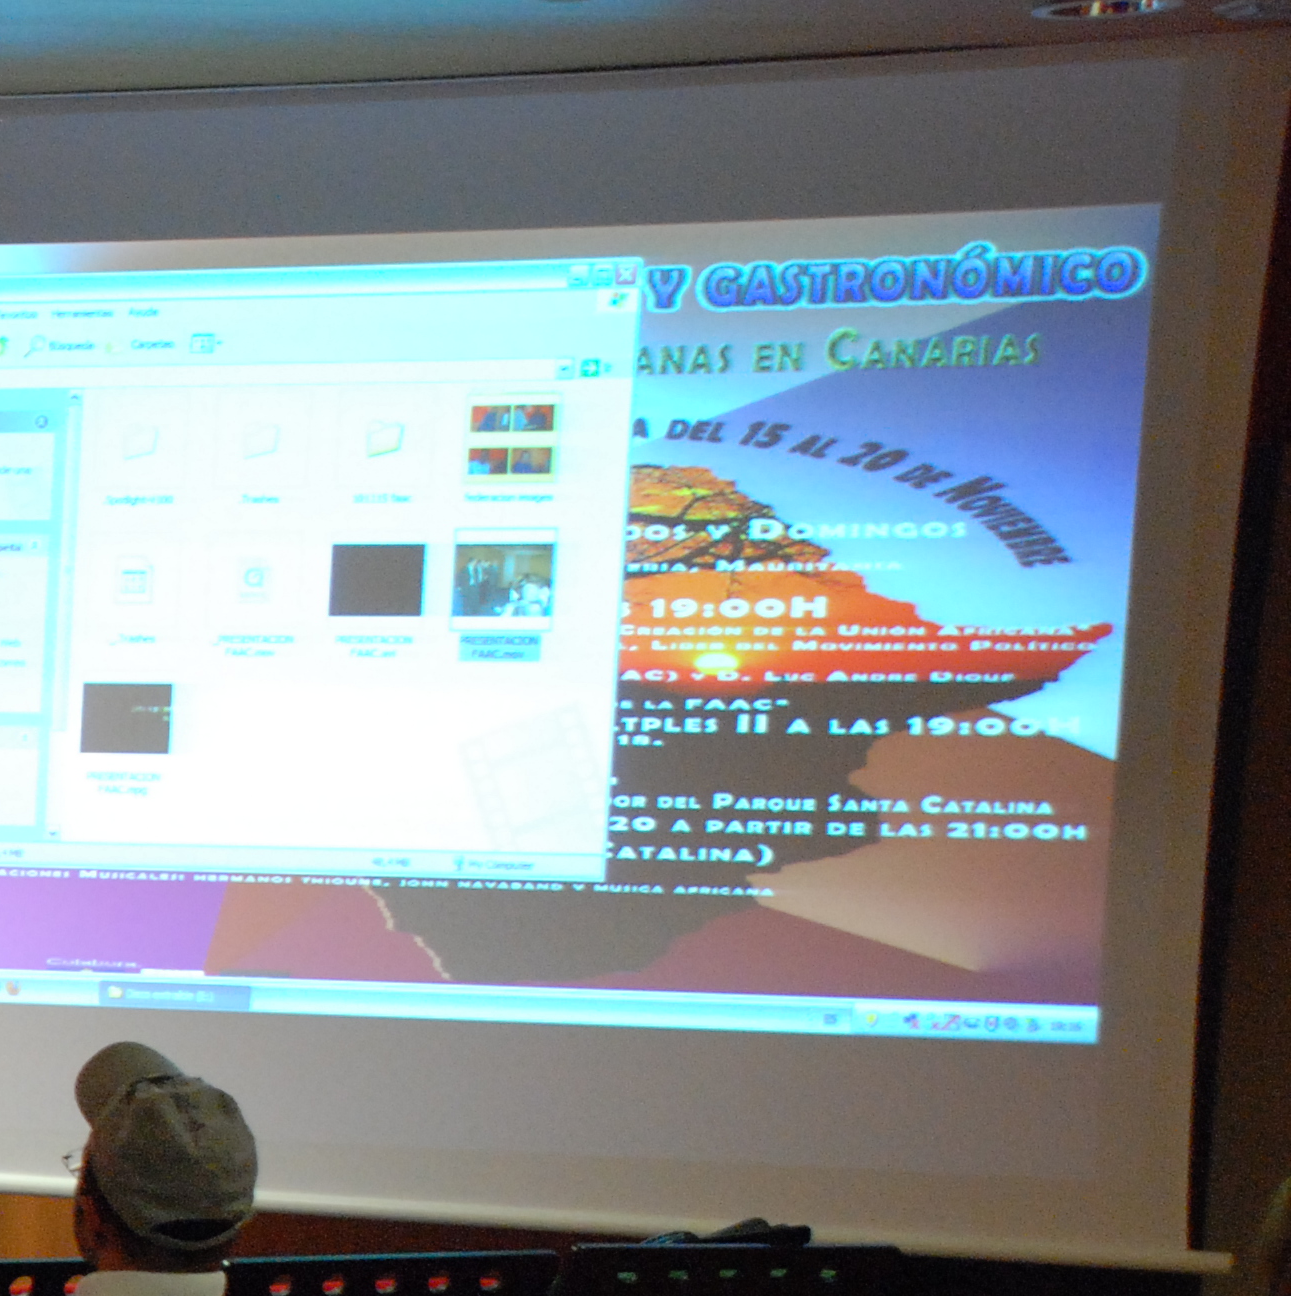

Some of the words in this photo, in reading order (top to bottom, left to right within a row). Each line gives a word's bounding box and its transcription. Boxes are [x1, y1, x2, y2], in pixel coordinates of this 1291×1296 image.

[646, 266, 690, 310] Y
[697, 241, 1148, 311] GASTRONÓMICO
[752, 341, 804, 373] EN
[825, 327, 1042, 372] CANARIAS
[665, 419, 724, 443] DEL
[738, 420, 793, 448] 15
[787, 433, 839, 459] AL
[837, 441, 909, 472] 20
[892, 462, 954, 489] DE
[748, 518, 968, 541] DOMINGOS
[651, 595, 828, 619] 19:00H
[620, 623, 743, 637] CREACIÓN
[752, 625, 784, 637] DE
[795, 625, 827, 637] LA
[837, 624, 927, 637] UNIÓN
[791, 639, 959, 651] MOVIMIENTO
[764, 670, 816, 682] LUC
[825, 669, 918, 683] ANDRE
[643, 699, 674, 711] LA
[614, 715, 719, 734] TPLES
[785, 717, 812, 735] A
[828, 717, 891, 736] LAS
[906, 715, 1082, 737] 19:00H
[612, 795, 648, 809] OR
[656, 796, 702, 810] DEL
[711, 791, 818, 813] PARQUE
[826, 793, 910, 814] SANTA
[919, 794, 1055, 816] CATALINA
[608, 815, 658, 833] 20
[670, 818, 693, 833] A
[704, 818, 814, 836] PARTIR
[825, 820, 866, 837] DE
[878, 821, 934, 838] LAS
[945, 821, 1089, 841] 21:00H
[193, 873, 293, 885] HERMANOS
[593, 883, 665, 894] MUSICA
[672, 884, 776, 897] AFRICANA
